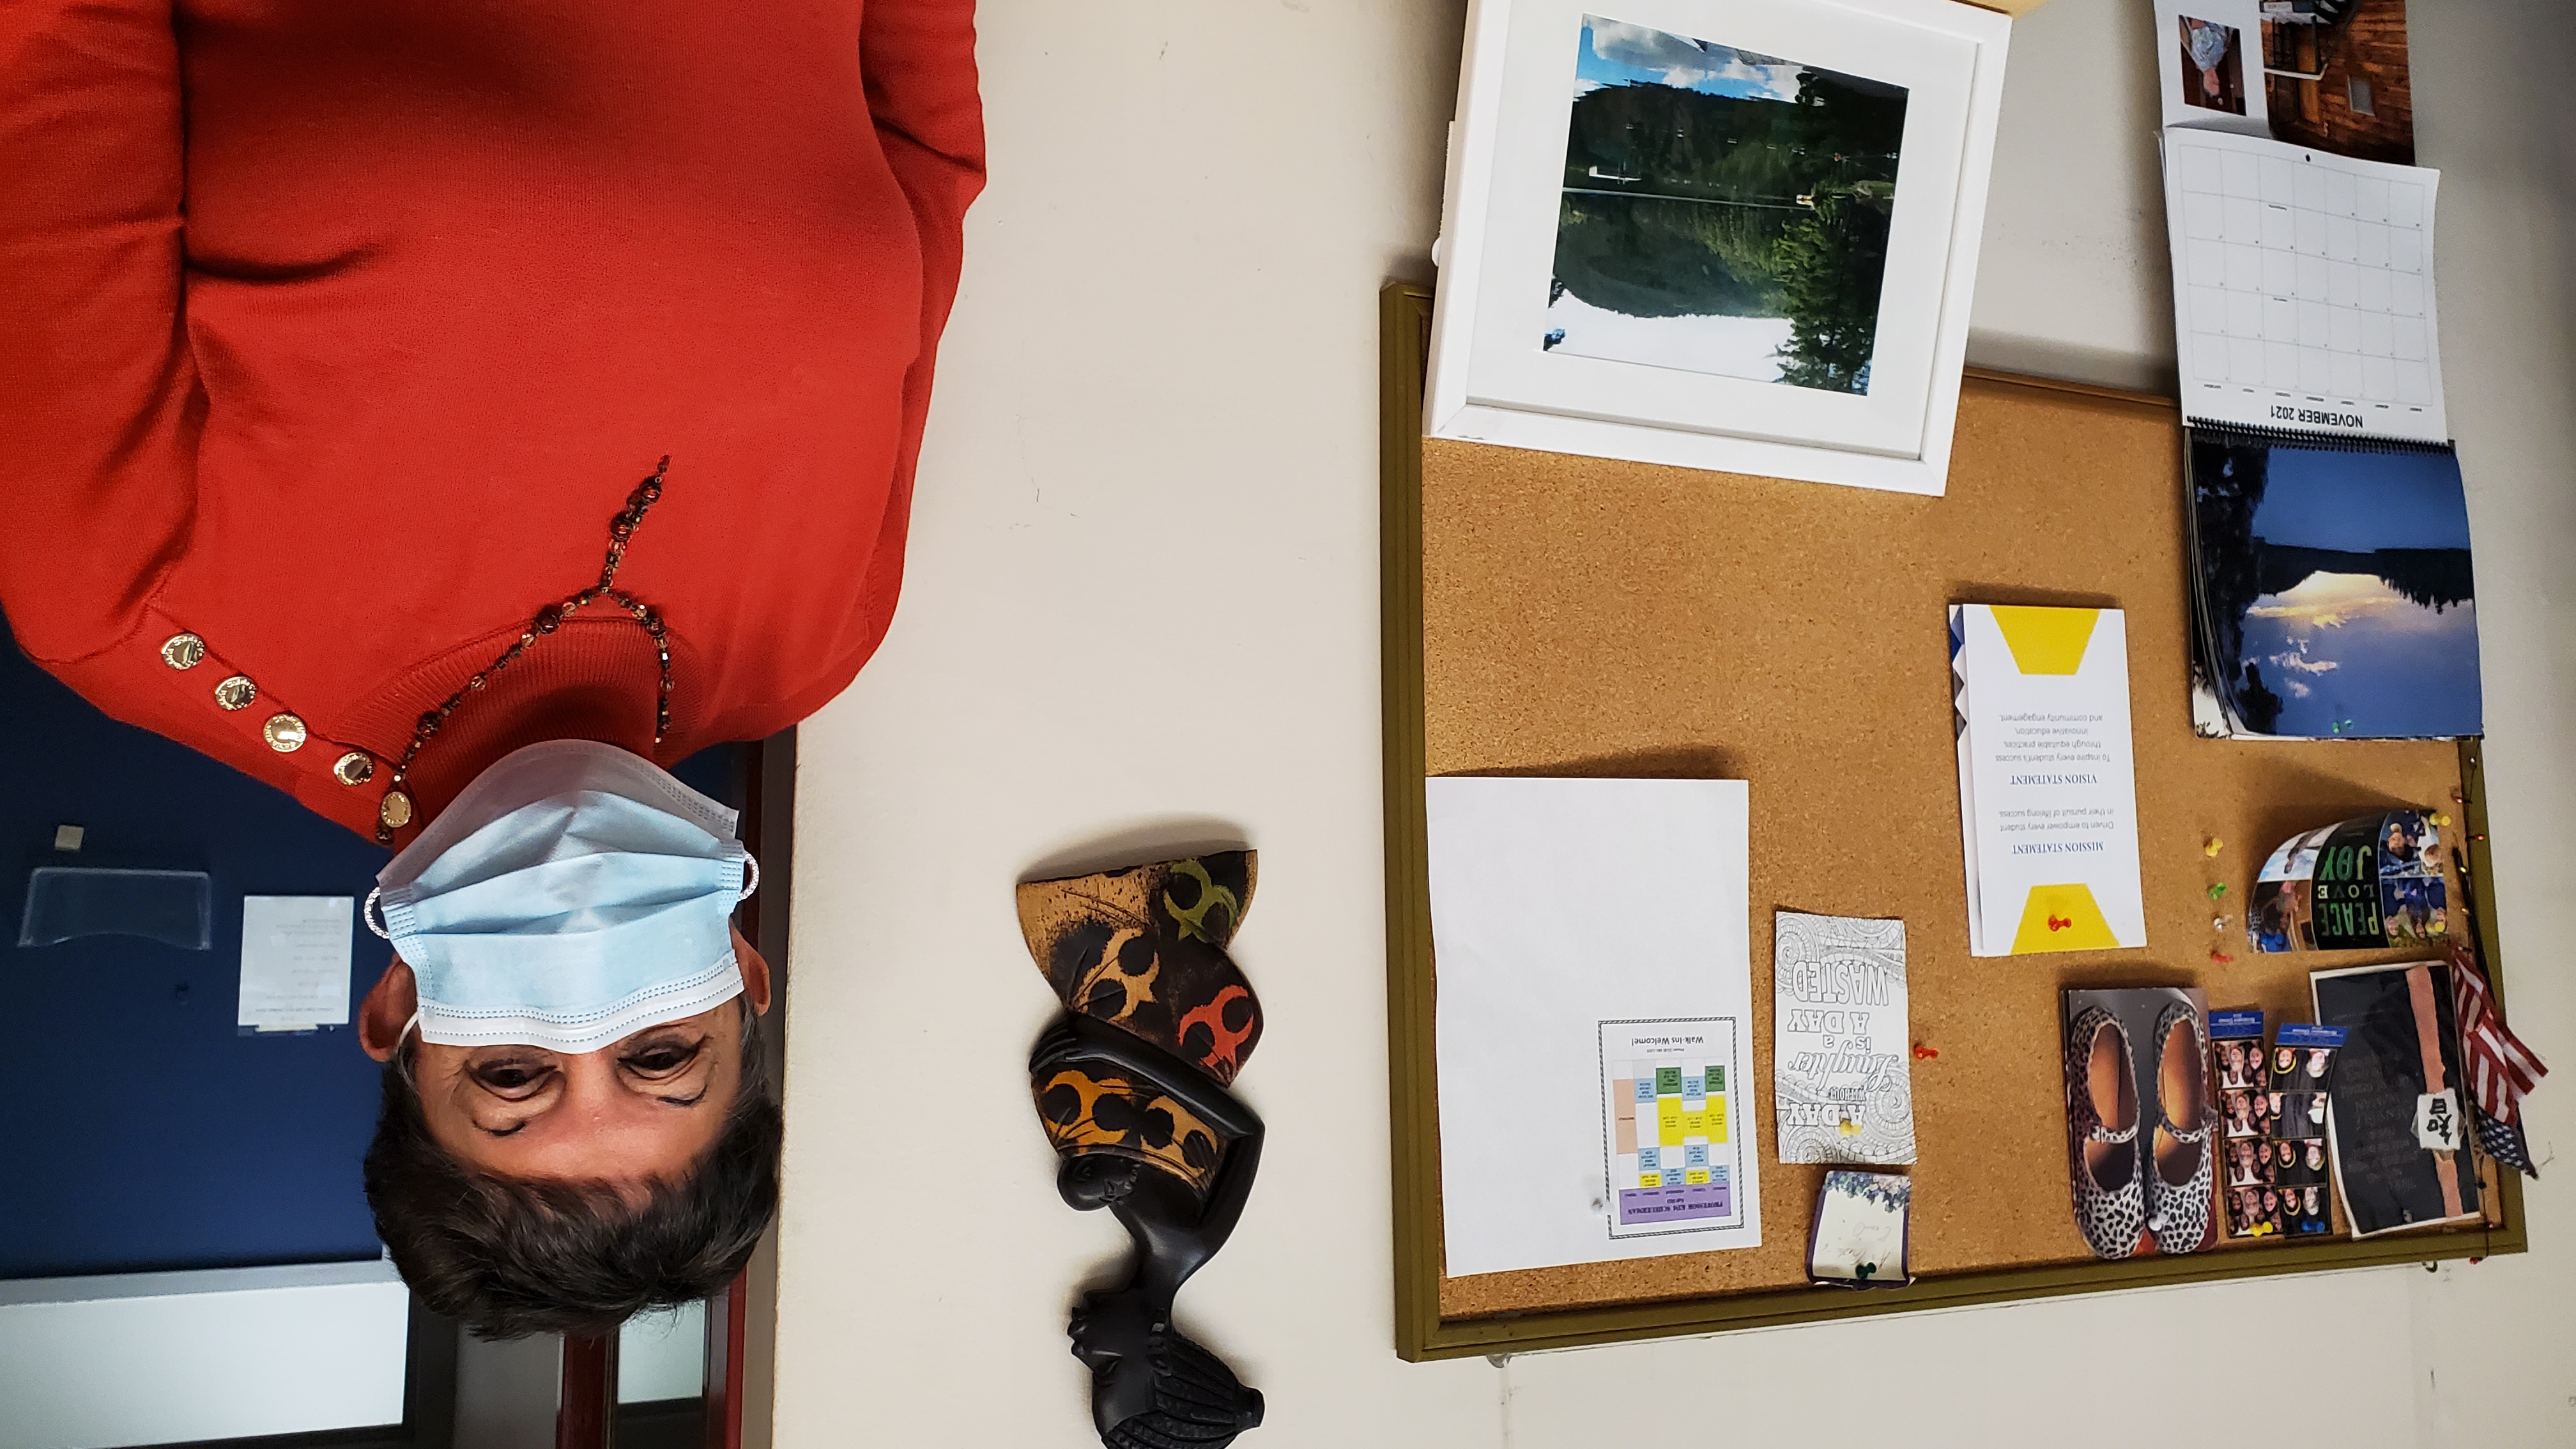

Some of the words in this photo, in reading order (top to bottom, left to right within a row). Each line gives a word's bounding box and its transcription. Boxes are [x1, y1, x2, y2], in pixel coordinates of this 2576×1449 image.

[2270, 404, 2295, 421] 2021
[2297, 408, 2363, 429] NOVEMBER
[2047, 714, 2087, 722] community
[2037, 740, 2070, 749] equitable
[2072, 740, 2101, 748] through
[2076, 753, 2101, 762] inspire
[2102, 754, 2110, 762] To
[2010, 775, 2063, 785] STATEMENT
[2065, 774, 2097, 784] VISION
[2027, 809, 2051, 818] lifelong
[2062, 808, 2087, 817] pursuit
[2047, 821, 2080, 830] empower
[2090, 821, 2114, 829] Driven
[2012, 843, 2063, 854] STATEMENT
[2065, 842, 2103, 852] MISSION
[2319, 845, 2372, 881] JOY
[2317, 884, 2375, 900] LOVE
[2318, 901, 2380, 936] PEACE
[1791, 960, 1889, 1007] WASTED
[1787, 1009, 1844, 1034] DAY
[1850, 1012, 1869, 1035] A
[1631, 1037, 1669, 1046] Welcome!
[1671, 1036, 1703, 1045] Walk-Ins
[1823, 1034, 1835, 1048] a
[1855, 1036, 1871, 1054] is
[1788, 1040, 1899, 1092] Laughter
[1828, 1087, 1866, 1101] WITHOUT
[1786, 1103, 1841, 1127] DAY
[1846, 1103, 1866, 1127] A
[2426, 1098, 2453, 1146] 智
